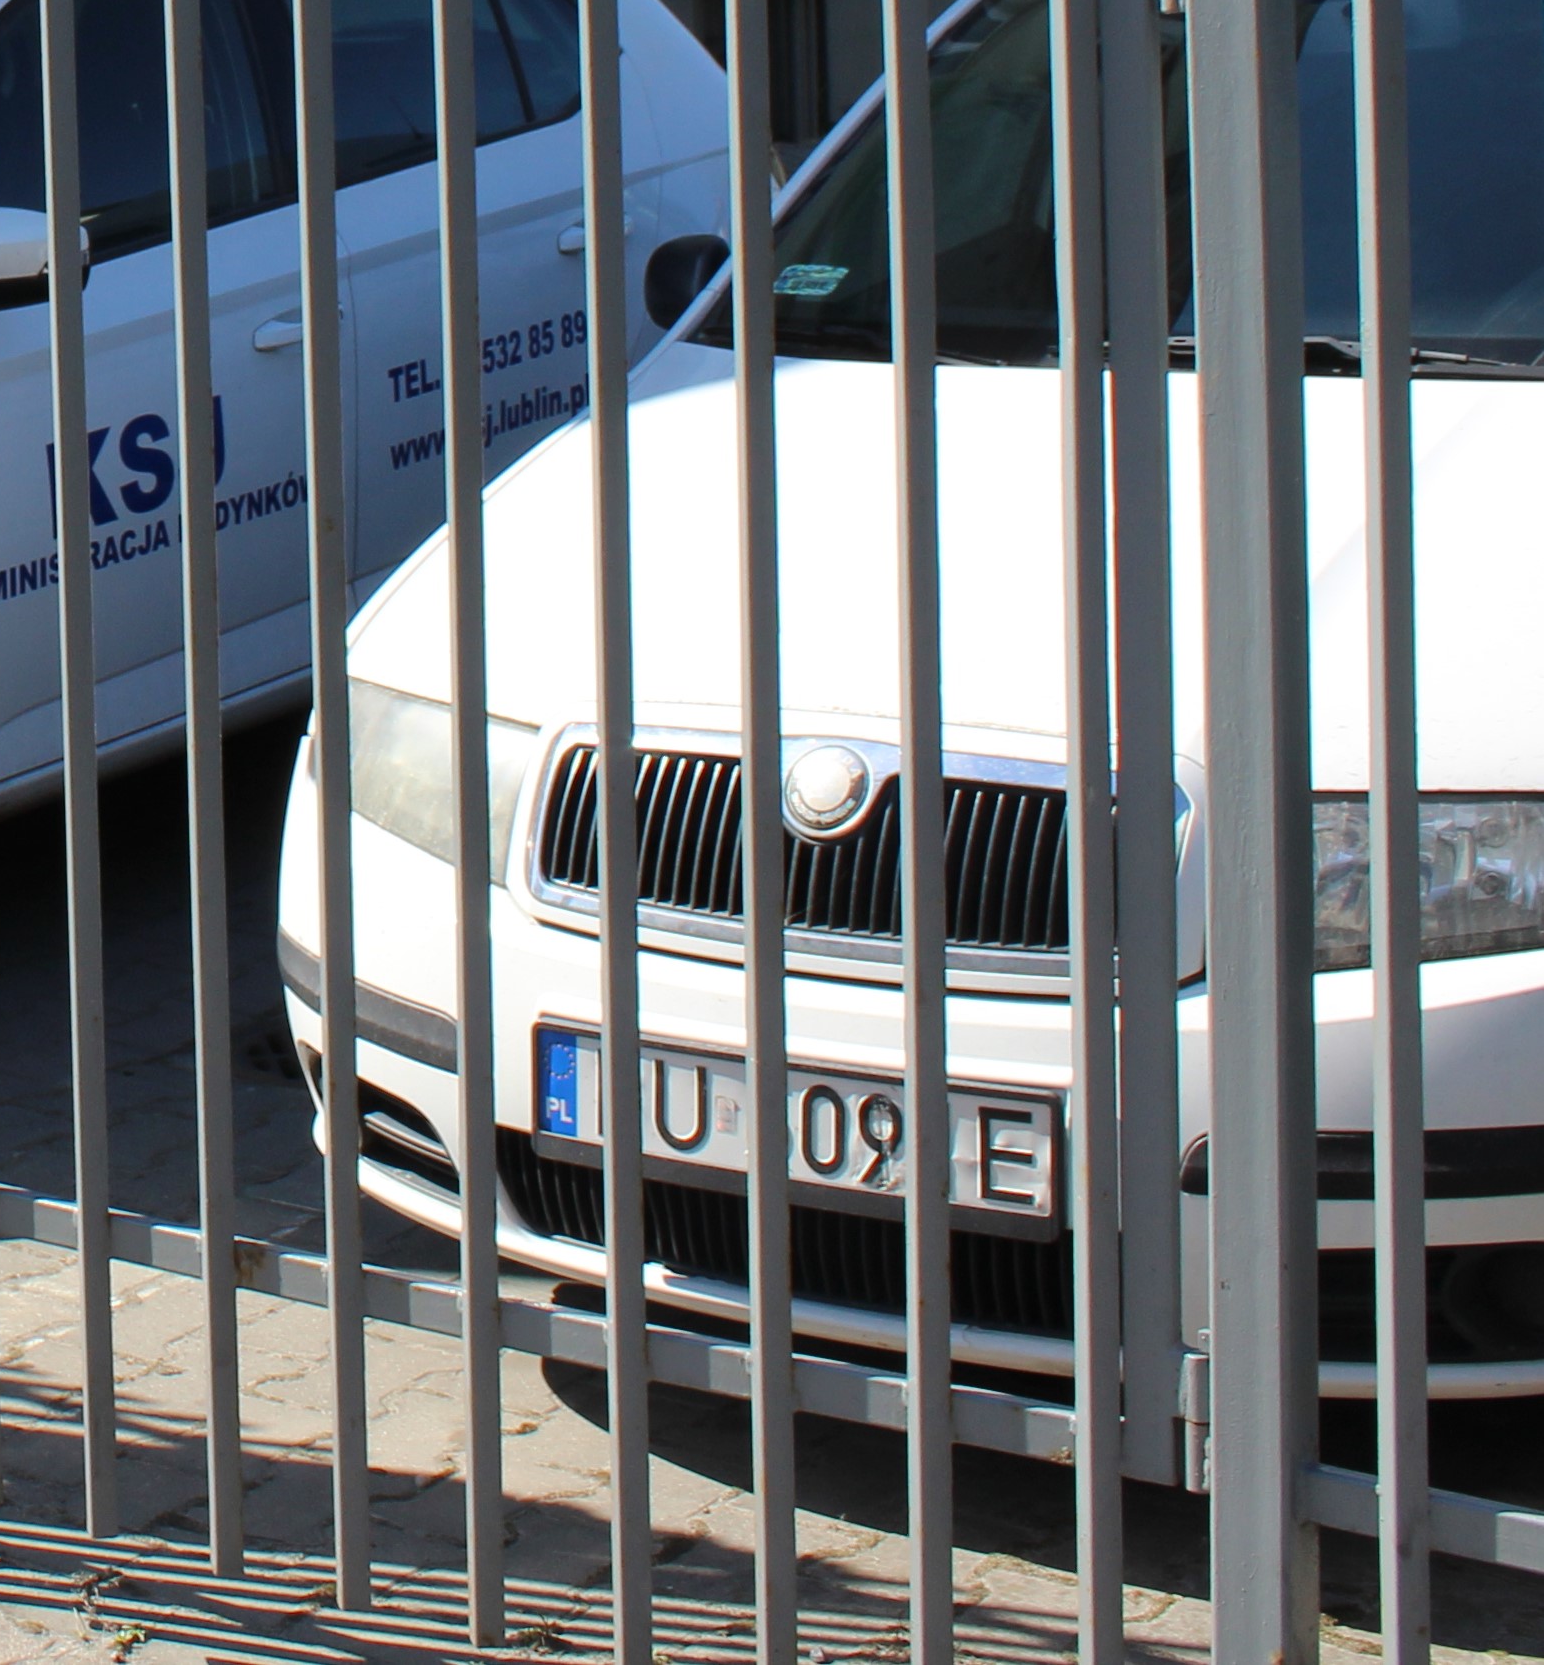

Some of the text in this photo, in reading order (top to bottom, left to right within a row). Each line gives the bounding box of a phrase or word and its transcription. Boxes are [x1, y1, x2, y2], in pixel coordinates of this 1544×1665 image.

[388, 309, 588, 403] TEL. 532 85 89
[545, 1095, 574, 1124] PL
[595, 1049, 707, 1150] U
